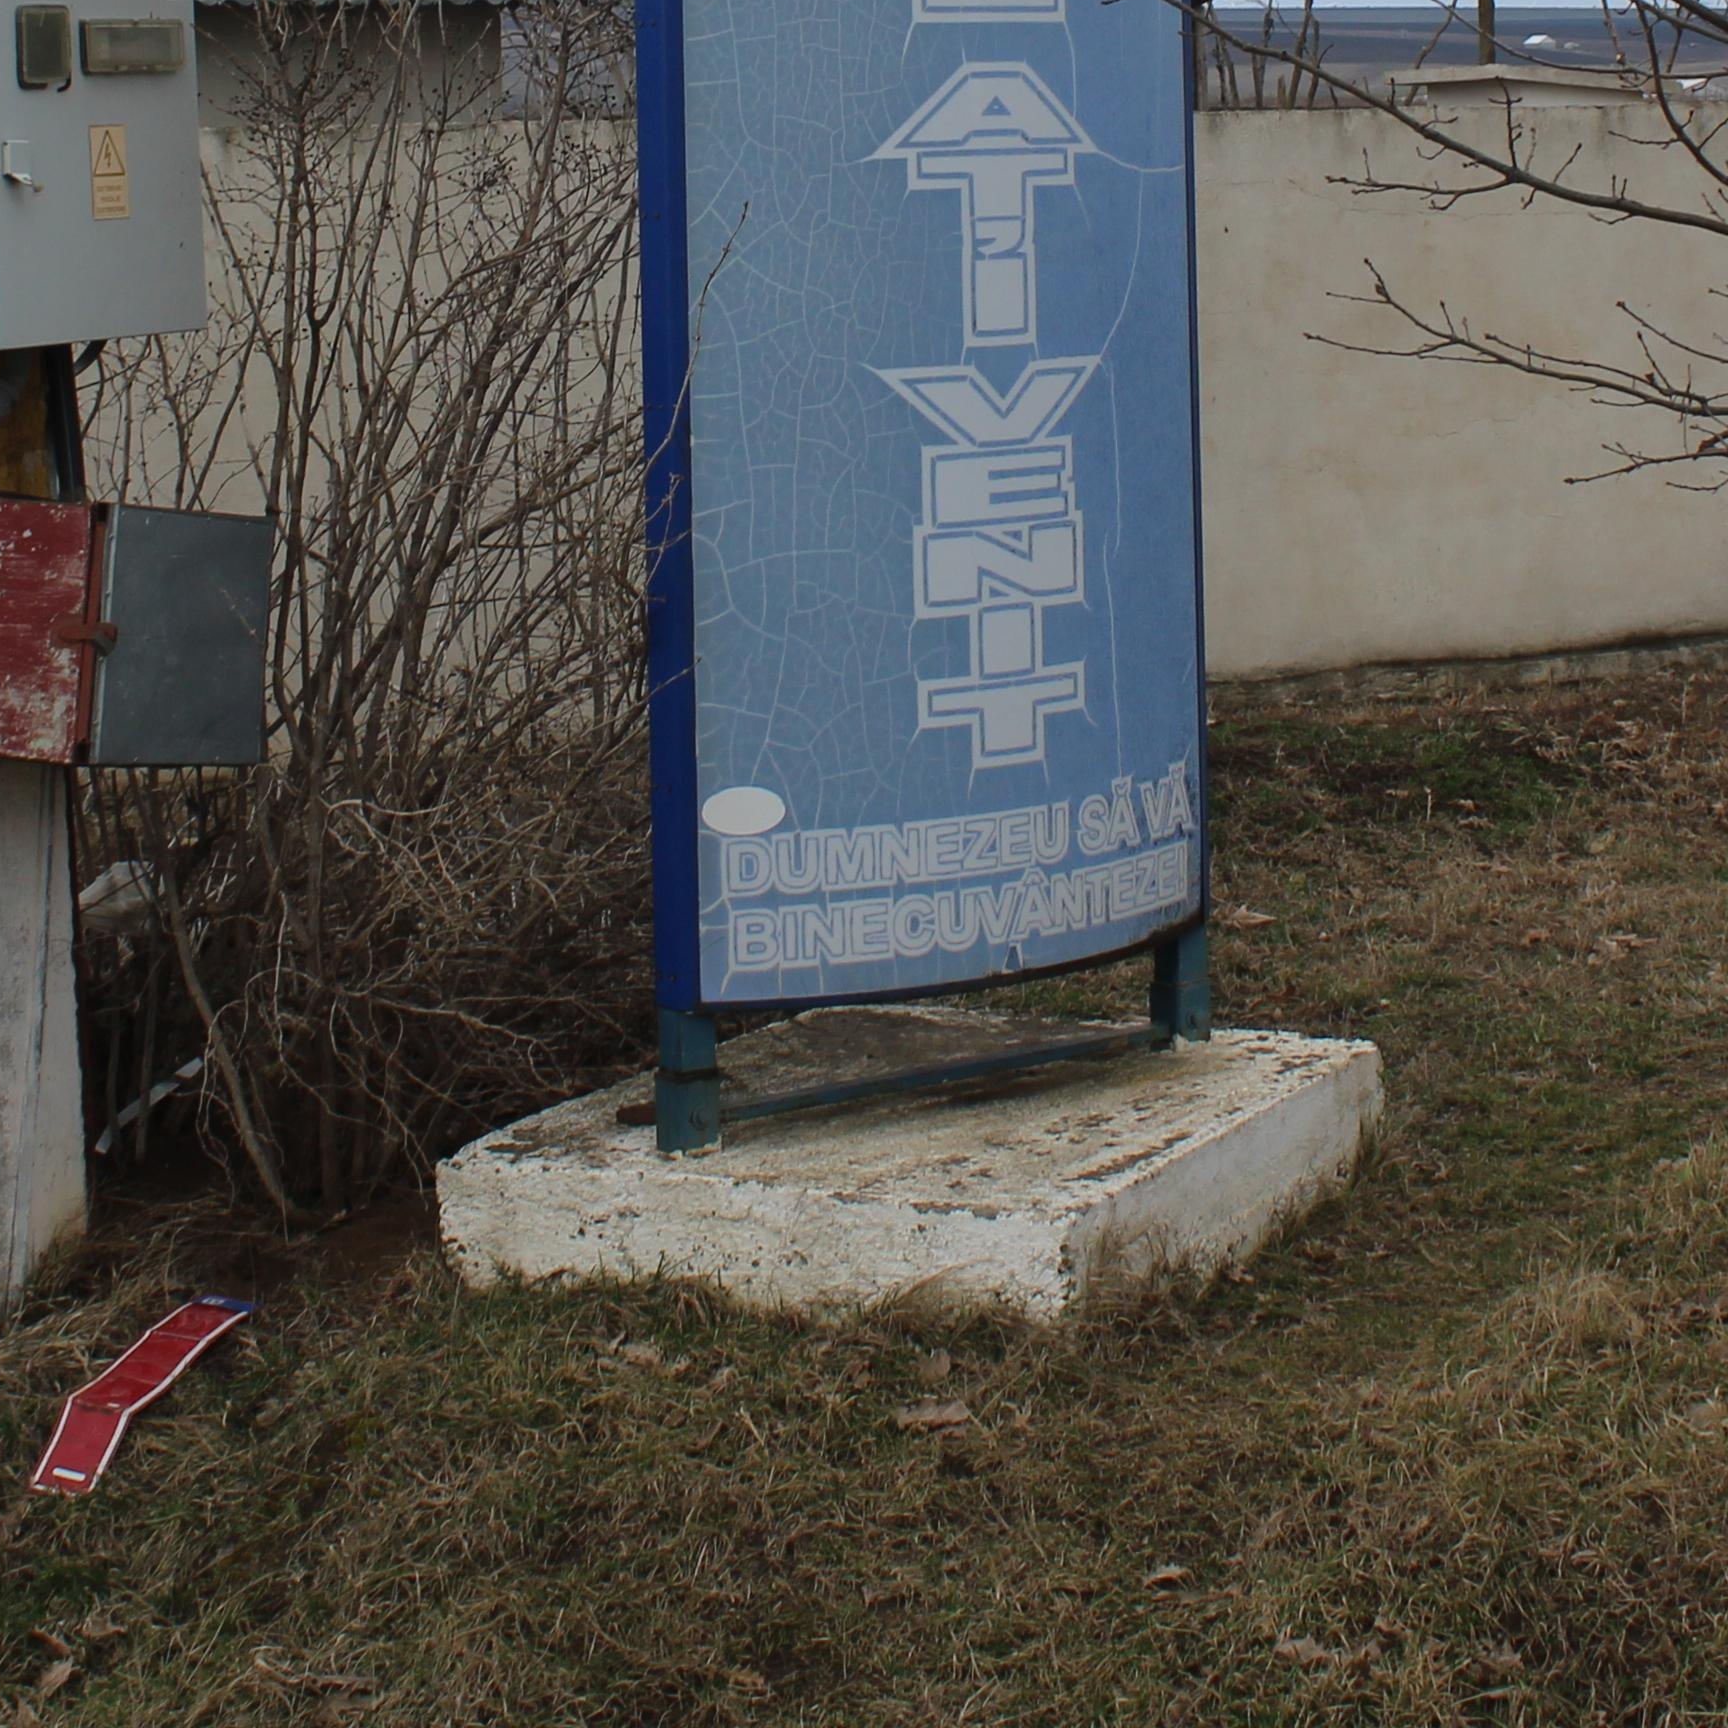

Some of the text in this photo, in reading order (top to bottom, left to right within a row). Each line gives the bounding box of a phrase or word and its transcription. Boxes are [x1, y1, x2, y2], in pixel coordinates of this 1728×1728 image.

[873, 355, 1100, 769] VENIT
[726, 760, 1194, 899] DUMNEZEU SĂ VĂ
